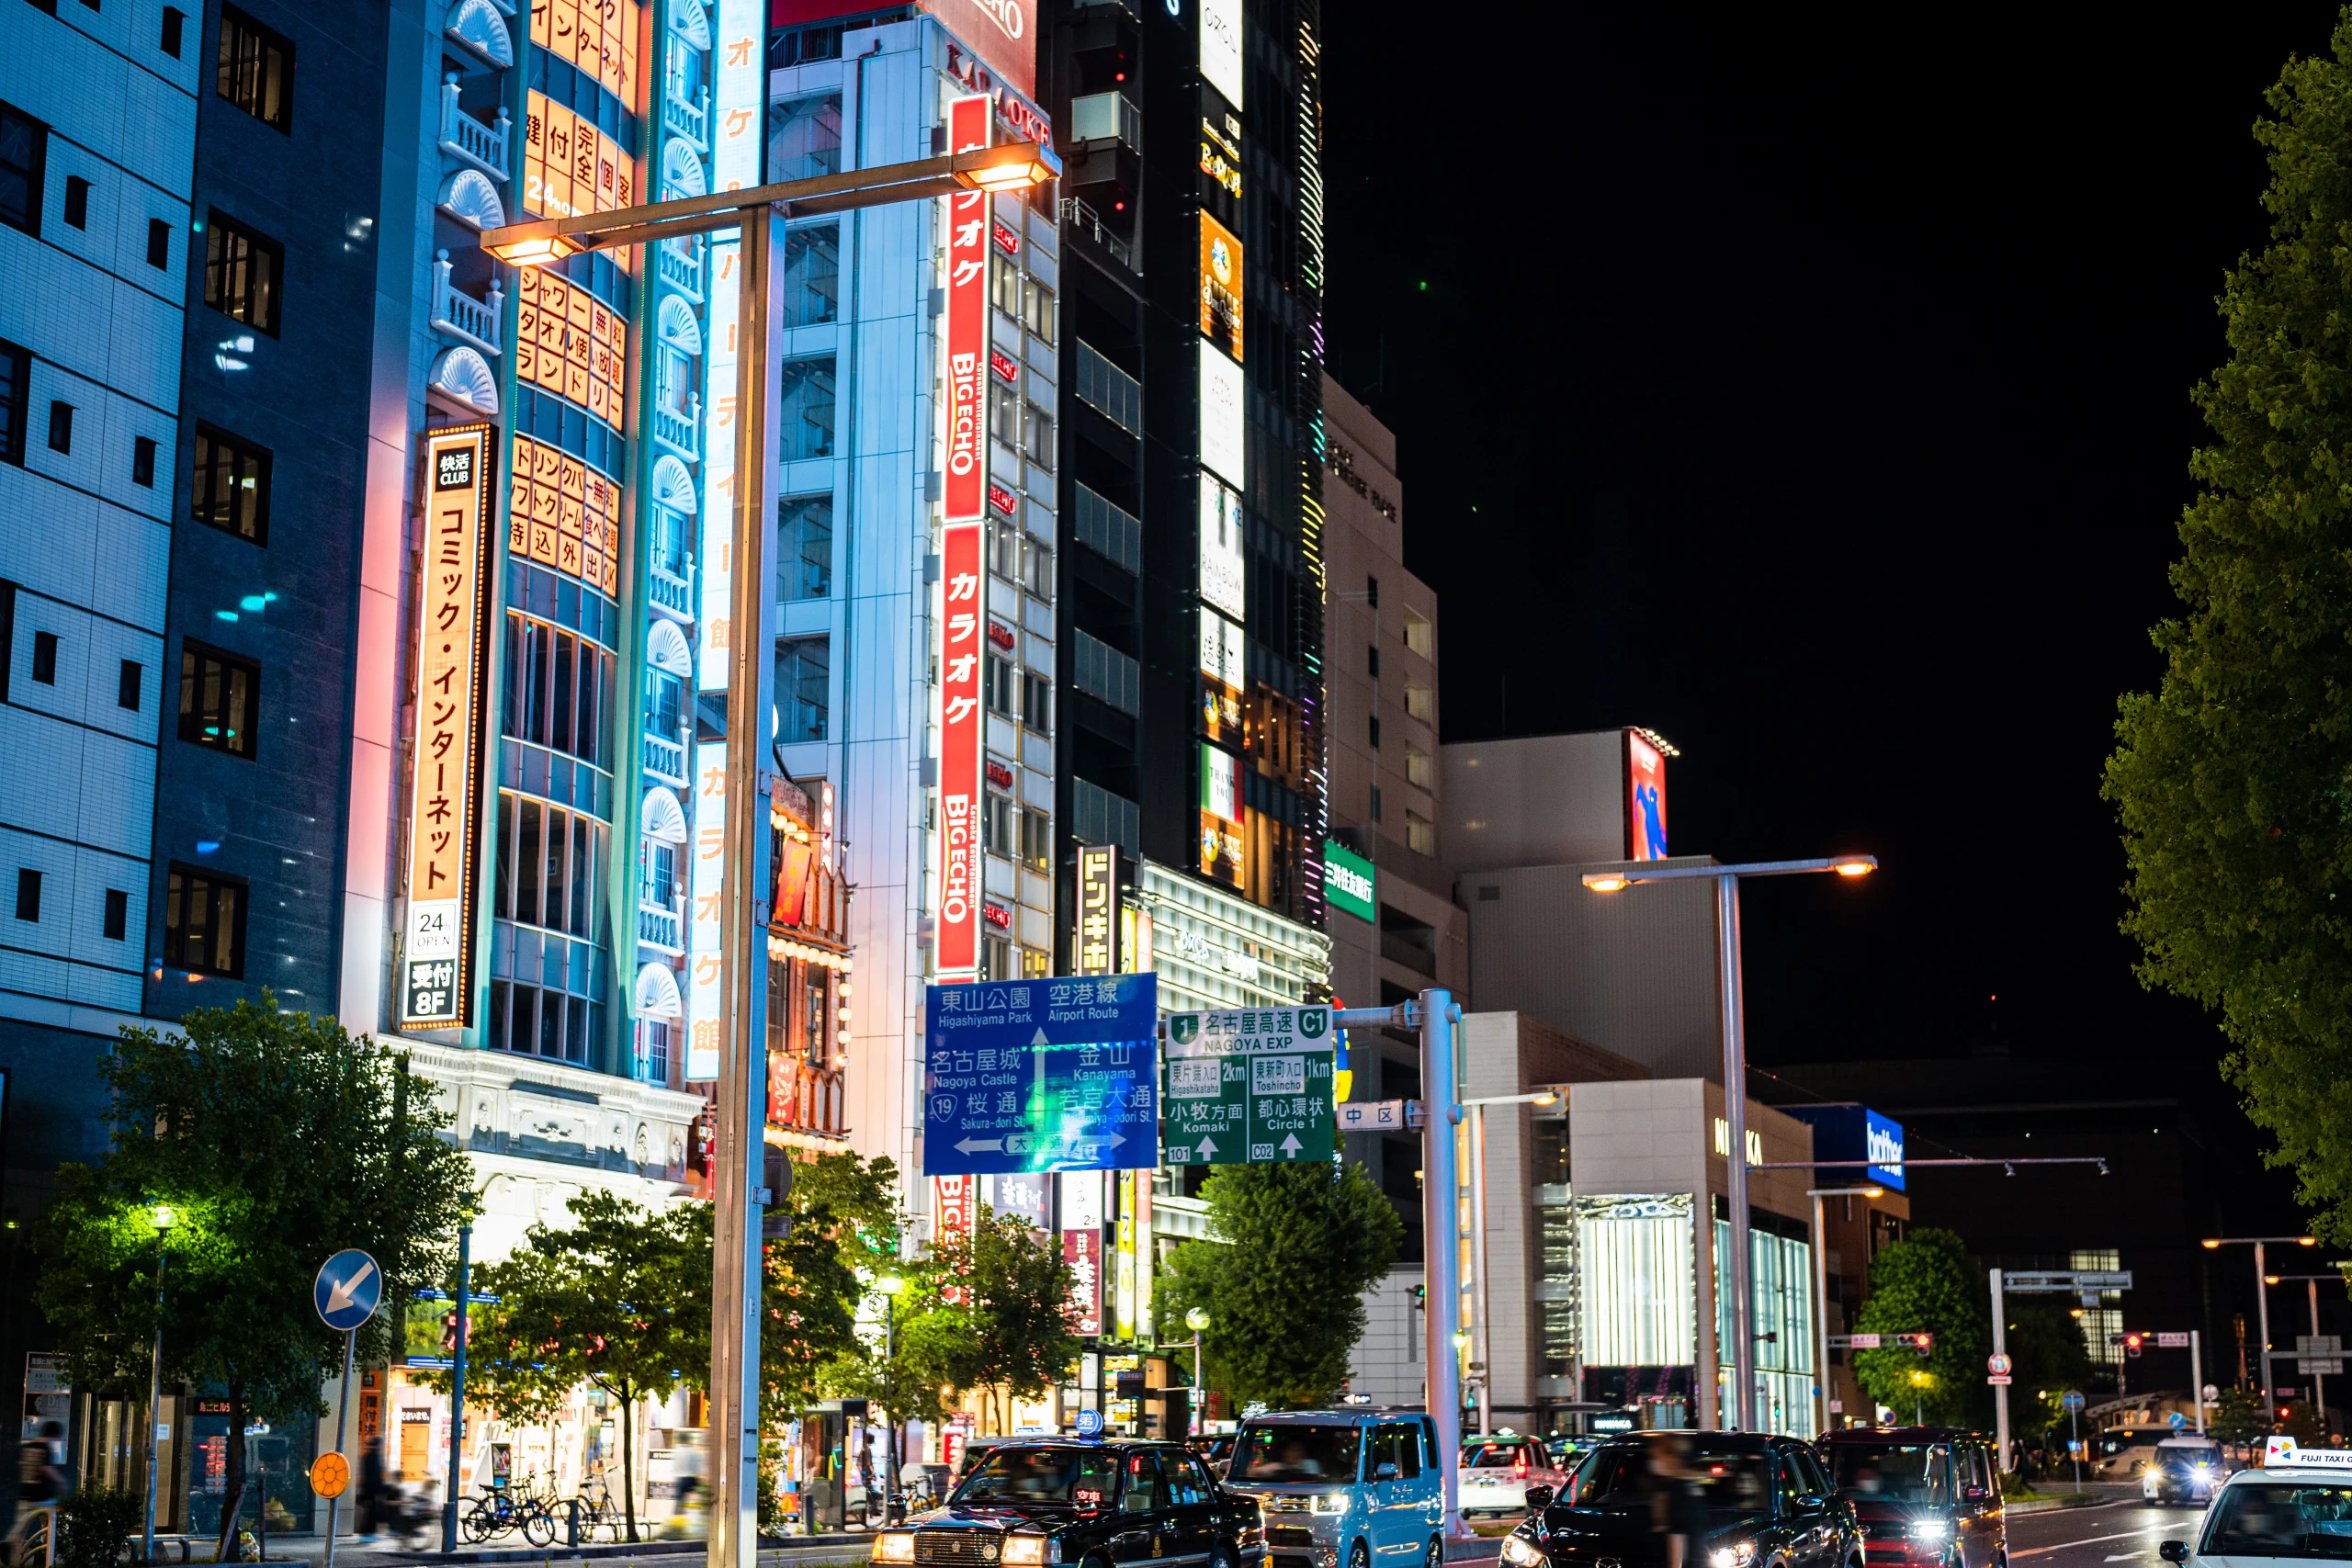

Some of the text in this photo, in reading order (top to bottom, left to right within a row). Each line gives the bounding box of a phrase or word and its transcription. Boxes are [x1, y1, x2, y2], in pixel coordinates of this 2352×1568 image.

[531, 4, 628, 85] インターネット
[952, 142, 984, 287] ラオケ
[523, 272, 622, 350] シャワー無料
[520, 310, 620, 385] タオル使い放題
[517, 346, 619, 413] ランドリー
[951, 352, 975, 476] BIG ECHO
[974, 362, 984, 461] Karaoke Entertainment
[440, 453, 469, 472] 快活
[439, 472, 469, 485] CLUB
[518, 445, 615, 513] ドリンクバー無料
[945, 572, 978, 725] カラオケ
[426, 509, 463, 890] コミック・インターネット
[944, 795, 968, 923] BIG ECHO
[967, 843, 977, 909] Entertainment
[416, 935, 450, 948] OPEN
[412, 963, 453, 989] 受付
[415, 990, 446, 1016] 8F
[941, 982, 1118, 1012] 東山公園 空港線
[938, 1007, 1119, 1029] Higashiyama Park Airport Route
[1179, 1018, 1190, 1038] 1
[1205, 1010, 1293, 1036] 名古屋高速
[1302, 1011, 1324, 1033] C1
[1204, 1036, 1293, 1053] NAGOYA EXP
[932, 1043, 1131, 1074] 名古屋城 金山
[933, 1068, 1136, 1089] Nagoya Castle Kanayama
[1222, 1062, 1246, 1082] 2km
[1255, 1060, 1330, 1080] 東新町入口 1km
[1170, 1082, 1220, 1096] Higashikataha
[1256, 1079, 1302, 1092] Toshincho
[936, 1085, 1151, 1115] 19 桜通 若宮大通
[1259, 1100, 1324, 1119] 都心環状
[1170, 1103, 1243, 1122] 小牧方面
[1346, 1108, 1393, 1124] 中区
[961, 1117, 1012, 1131] Sakura-dori
[1182, 1121, 1229, 1134] Komaki
[1267, 1119, 1305, 1131] Circle
[1252, 1145, 1272, 1159] C02
[1715, 1118, 1763, 1166] NIKA
[1867, 1122, 1903, 1177] brother
[1170, 1147, 1190, 1161] 101
[1079, 1413, 1093, 1429] 第一
[2301, 1454, 2322, 1462] FUJI
[2324, 1455, 2345, 1463] TAXI
[1077, 1490, 1101, 1502] 空車
